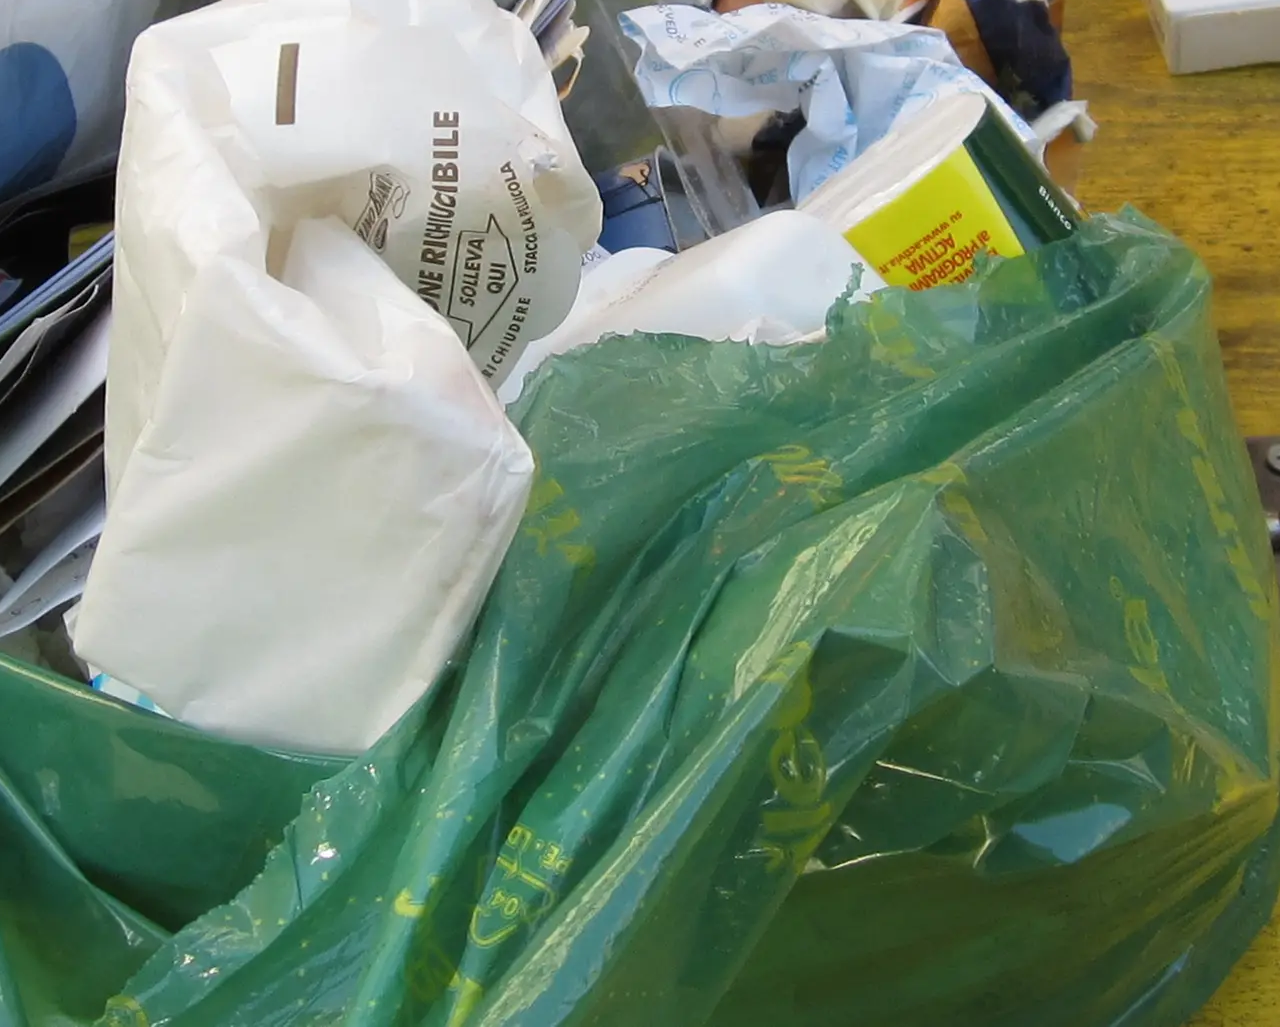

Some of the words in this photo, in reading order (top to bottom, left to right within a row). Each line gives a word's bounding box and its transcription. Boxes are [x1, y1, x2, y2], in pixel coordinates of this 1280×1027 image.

[1037, 184, 1073, 231] Bianco
[459, 237, 486, 307] SOLLEVA
[904, 231, 958, 276] ACTIVIA
[486, 262, 508, 295] QUI
[481, 296, 532, 379] RICHIUDERE
